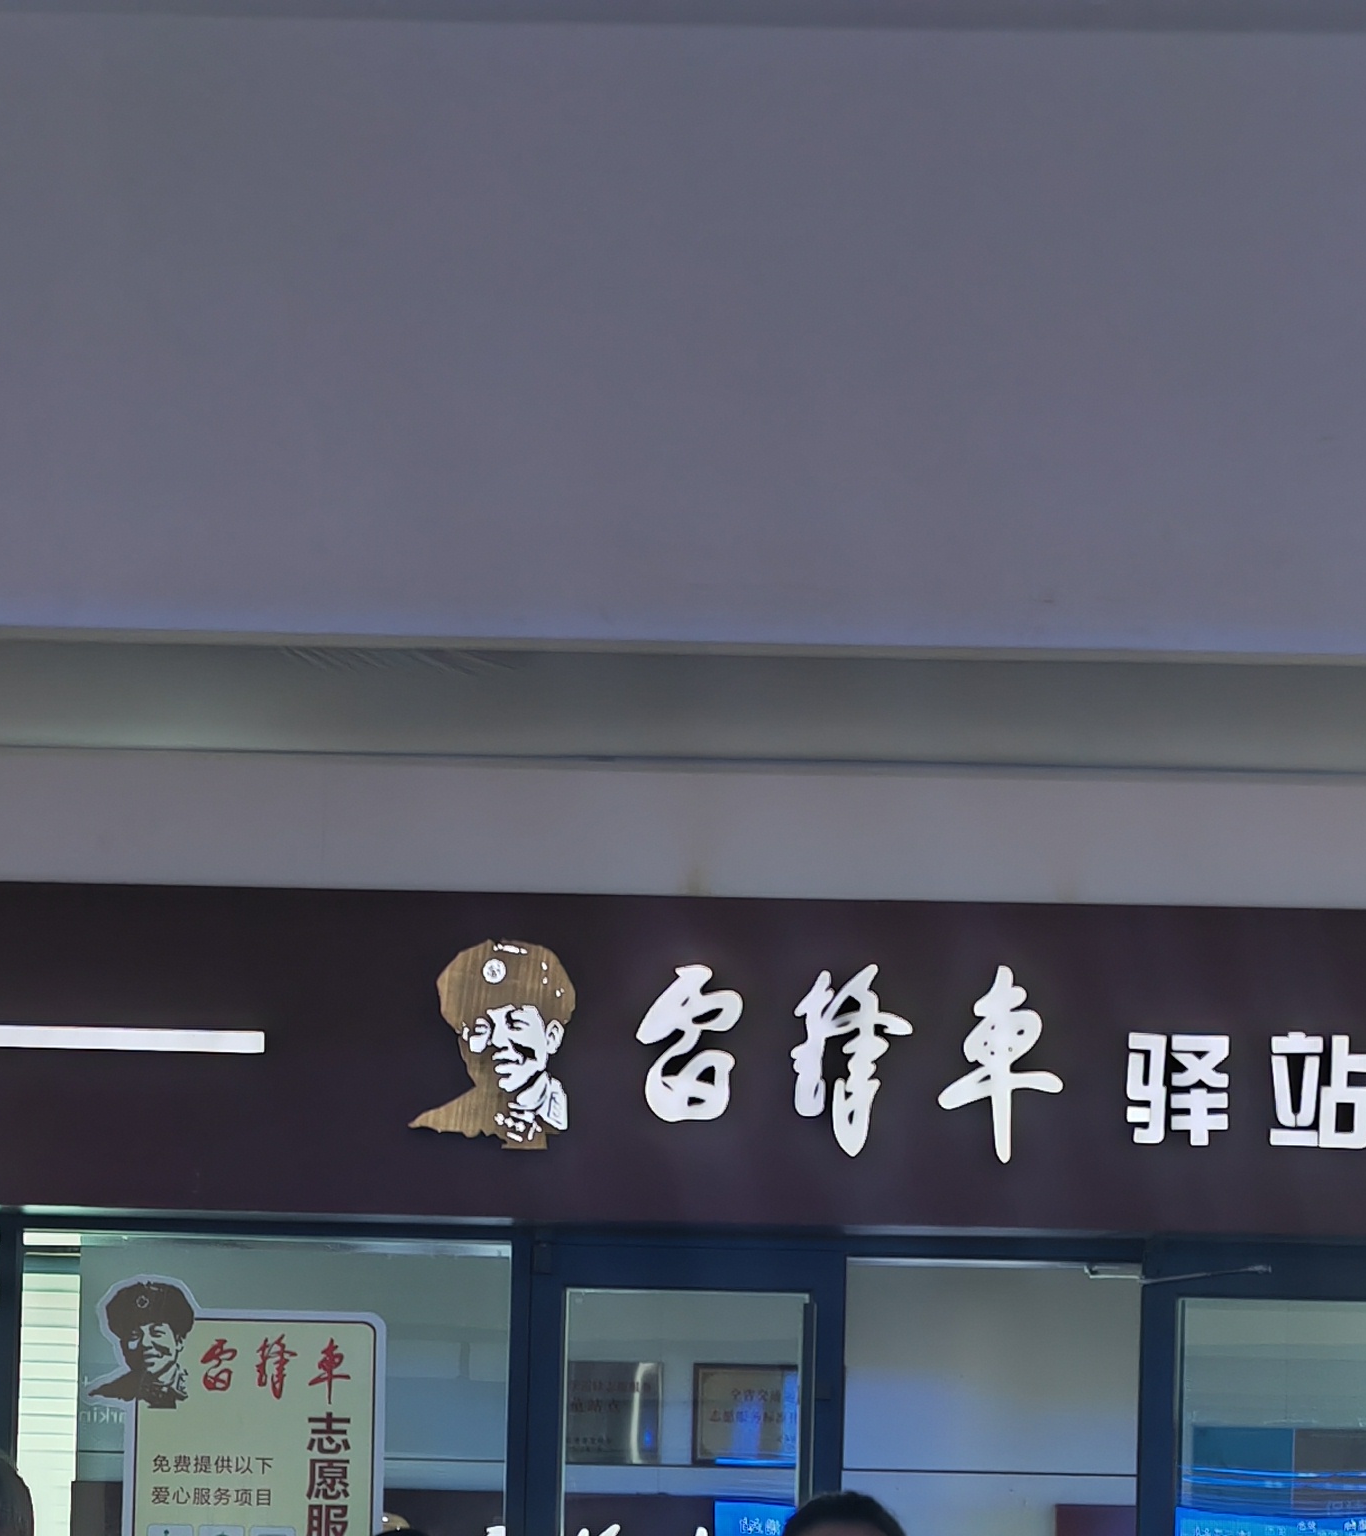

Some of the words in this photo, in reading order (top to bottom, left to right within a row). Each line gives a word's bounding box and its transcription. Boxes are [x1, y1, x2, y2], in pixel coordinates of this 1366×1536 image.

[152, 1454, 274, 1476] 免费提供以下
[150, 1485, 274, 1508] 爱心服务项目
